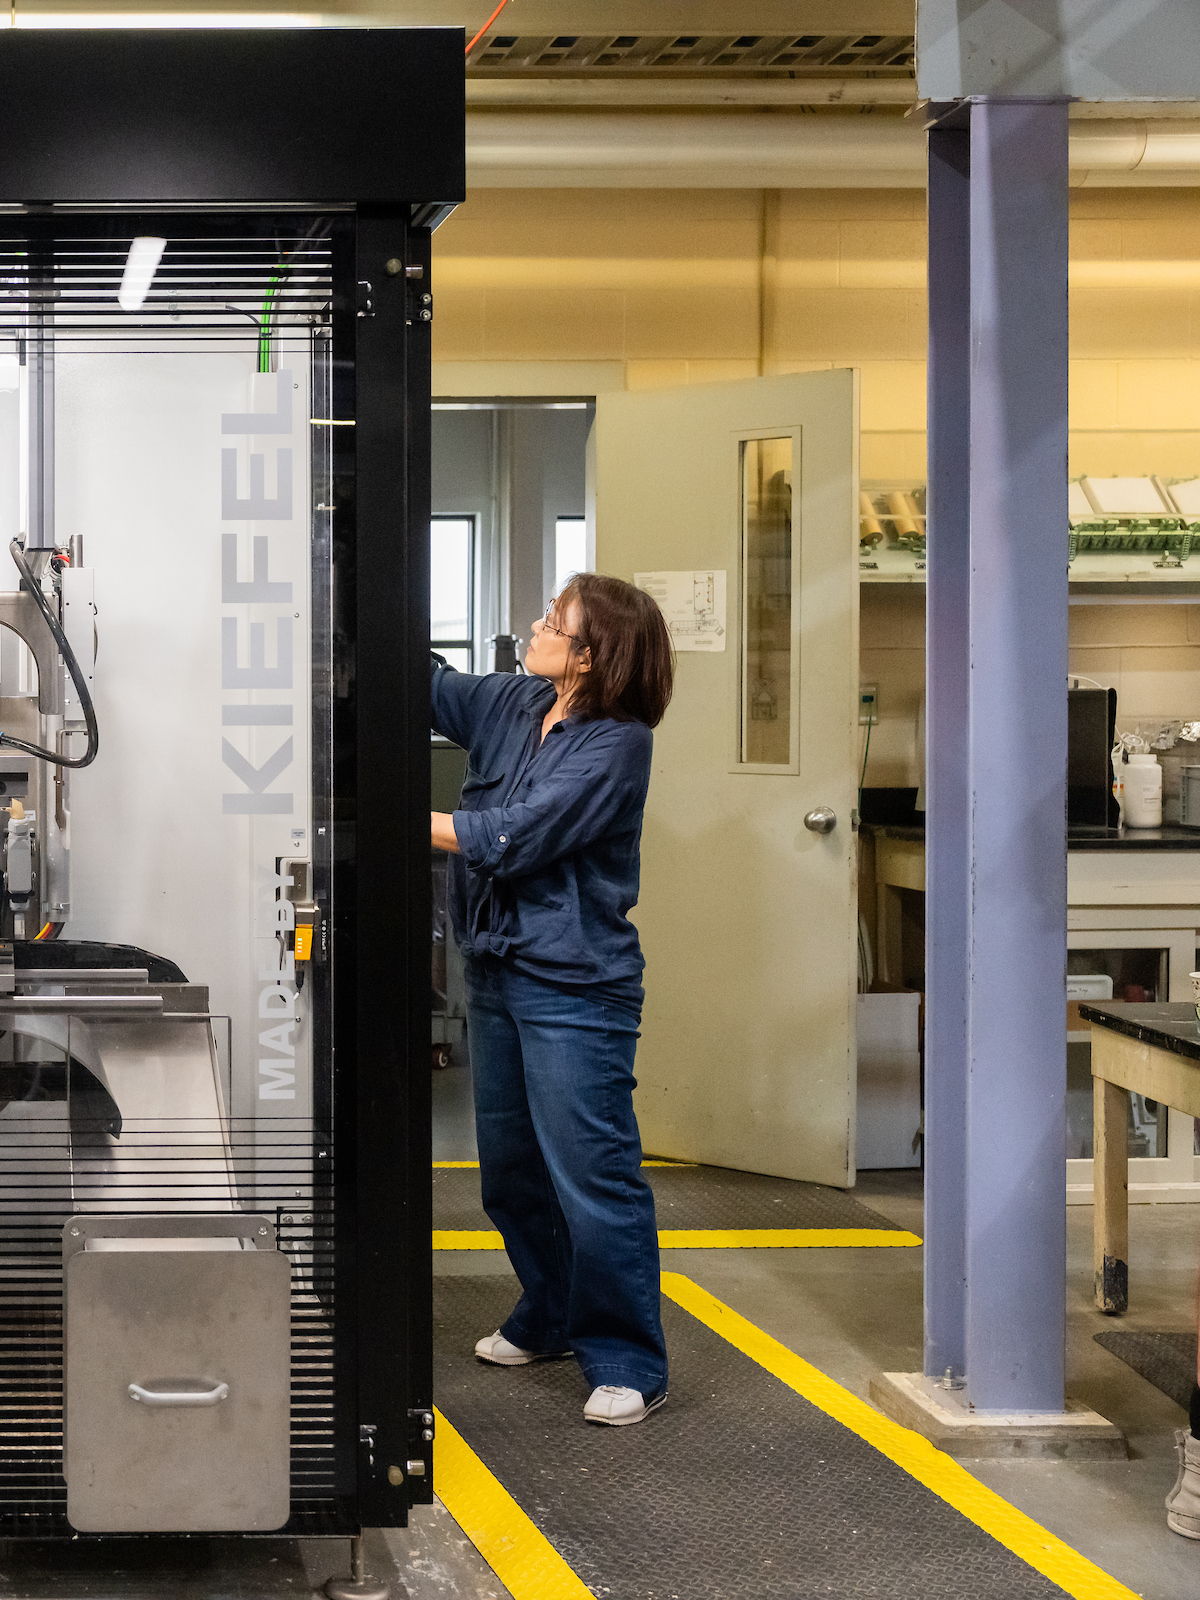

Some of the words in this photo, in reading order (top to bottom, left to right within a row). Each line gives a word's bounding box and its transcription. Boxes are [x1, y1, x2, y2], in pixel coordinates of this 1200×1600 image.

[221, 369, 293, 814] KIEFEL
[258, 863, 295, 931] BY
[258, 950, 295, 1100] MADE
